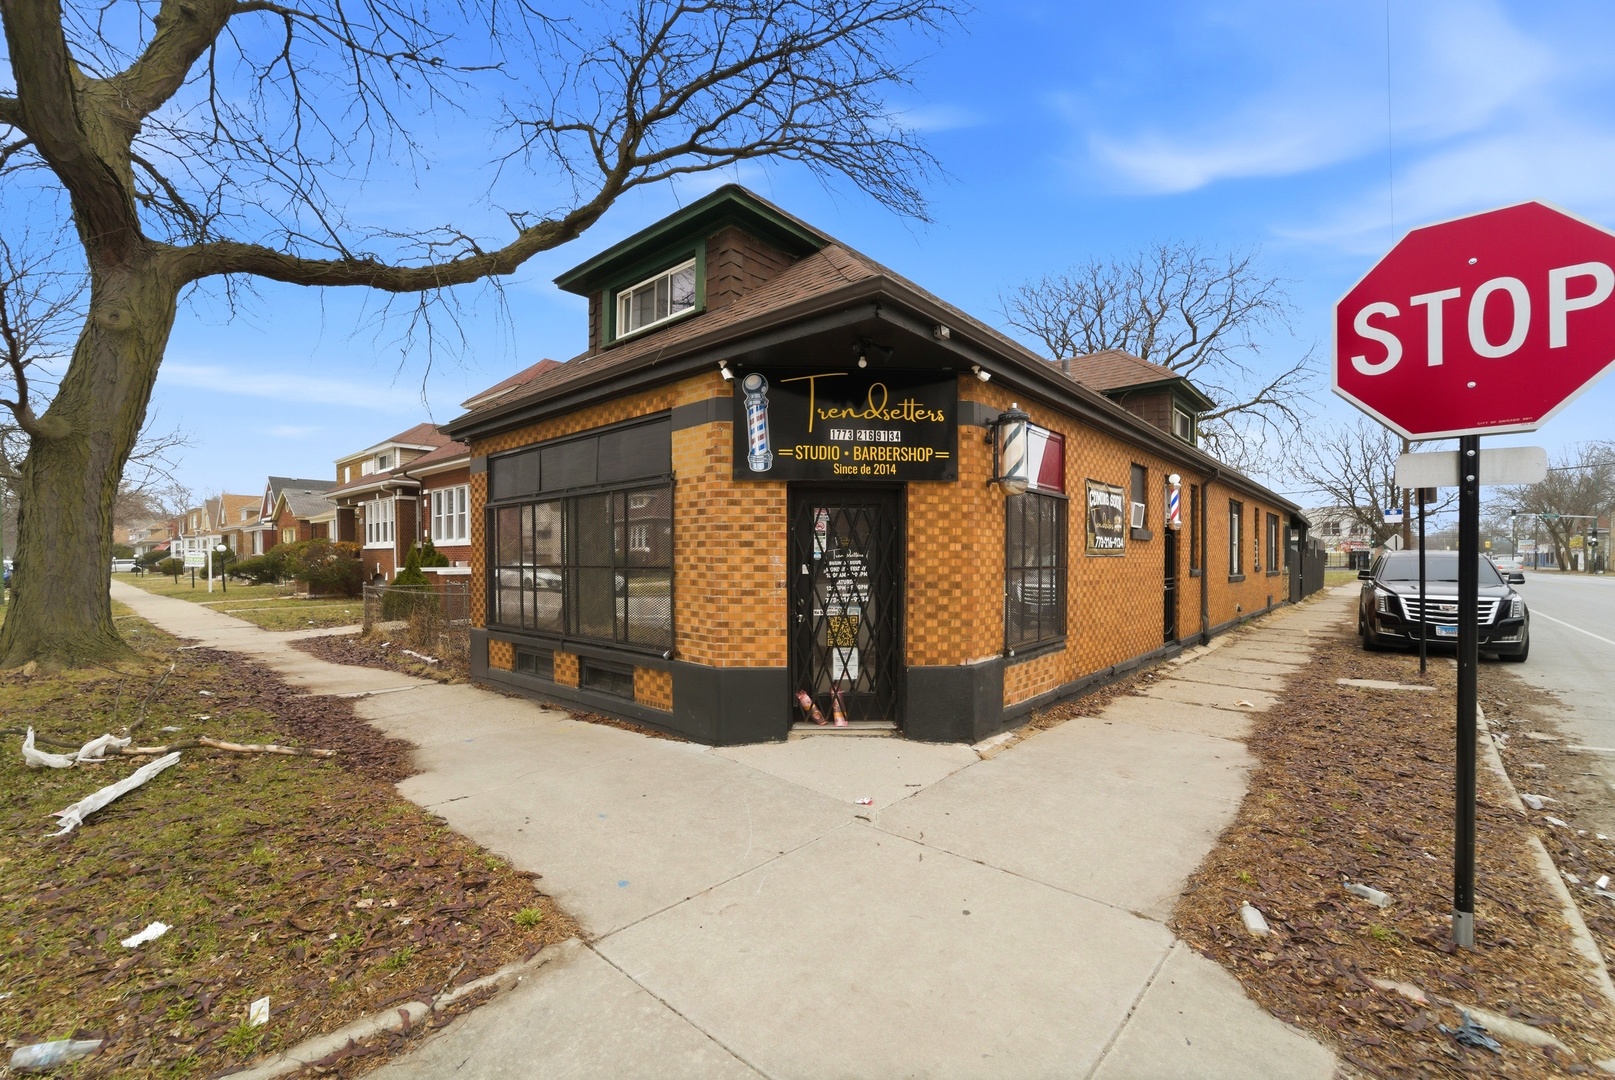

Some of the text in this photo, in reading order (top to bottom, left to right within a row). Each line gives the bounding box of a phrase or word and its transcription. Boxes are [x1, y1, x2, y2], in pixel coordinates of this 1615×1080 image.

[1350, 261, 1615, 376] STOP
[780, 372, 945, 433] Trendsetters
[831, 429, 853, 440] 1773
[795, 445, 933, 462] STUDIO BARBERSHOP
[833, 463, 897, 475] Since de 2014
